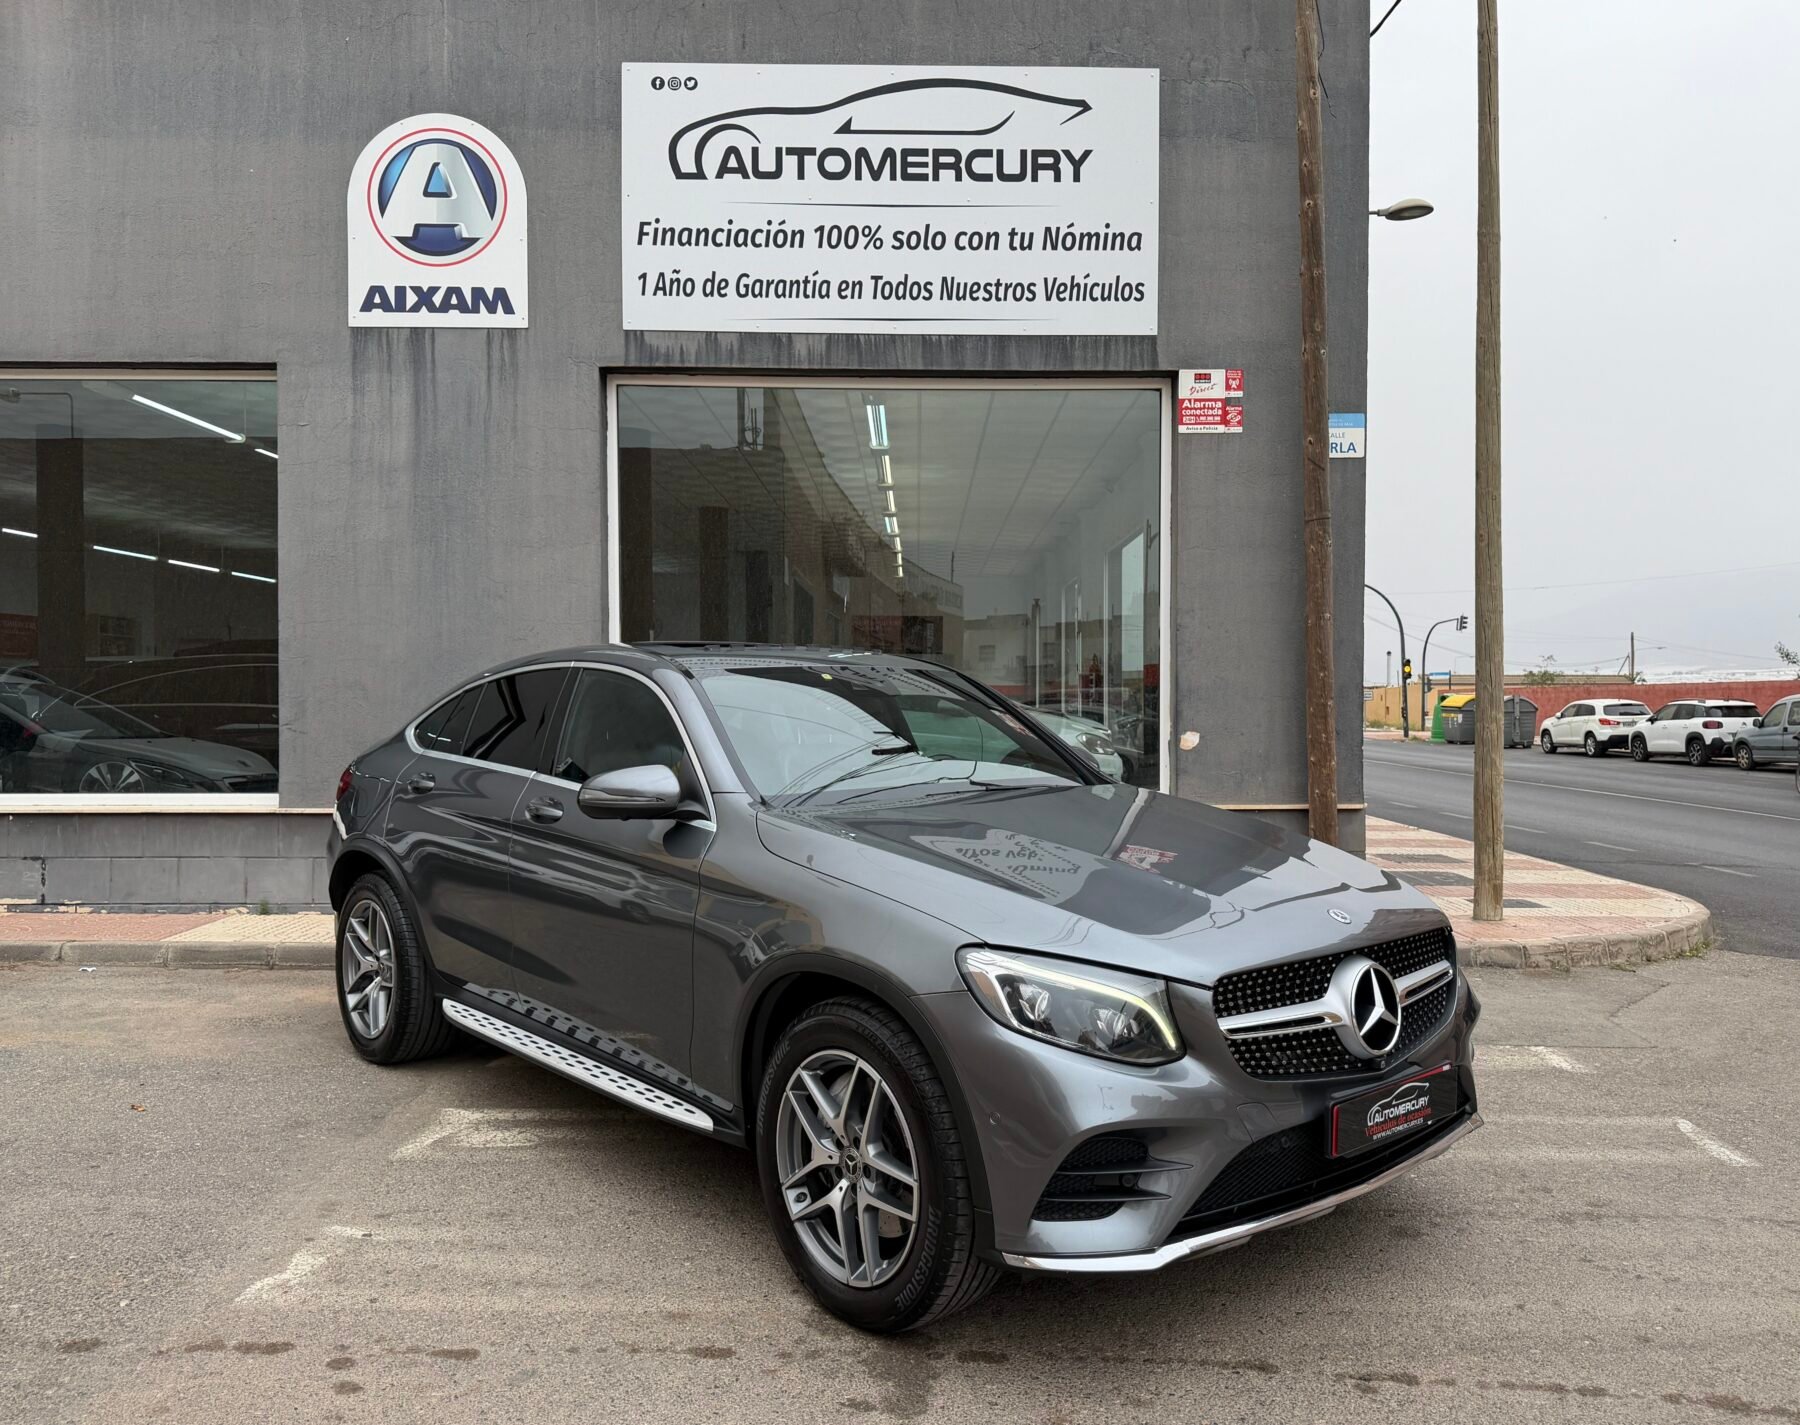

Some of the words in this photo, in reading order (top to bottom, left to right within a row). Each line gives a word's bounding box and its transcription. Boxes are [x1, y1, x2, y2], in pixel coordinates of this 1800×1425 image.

[714, 146, 1094, 183] AUTOMERCURY
[637, 219, 805, 249] Financiación
[813, 224, 884, 250] 100%
[891, 223, 947, 251] solo
[954, 230, 1000, 251] con
[1007, 227, 1035, 252] tu
[1042, 222, 1143, 252] Nómina
[359, 285, 516, 315] AIXAM
[637, 272, 648, 297] 1
[652, 269, 696, 297] Año
[702, 271, 730, 298] de
[735, 271, 831, 300] Garantía
[837, 279, 864, 300] en
[870, 274, 934, 302] Todos
[939, 277, 1037, 303] Nuestros
[1043, 273, 1145, 303] Vehículos
[1182, 399, 1222, 408] Alarma
[1182, 407, 1222, 415] conectada
[1374, 1095, 1429, 1123] AUTOMERCURY
[894, 1204, 942, 1312] BRIDGESTONE
